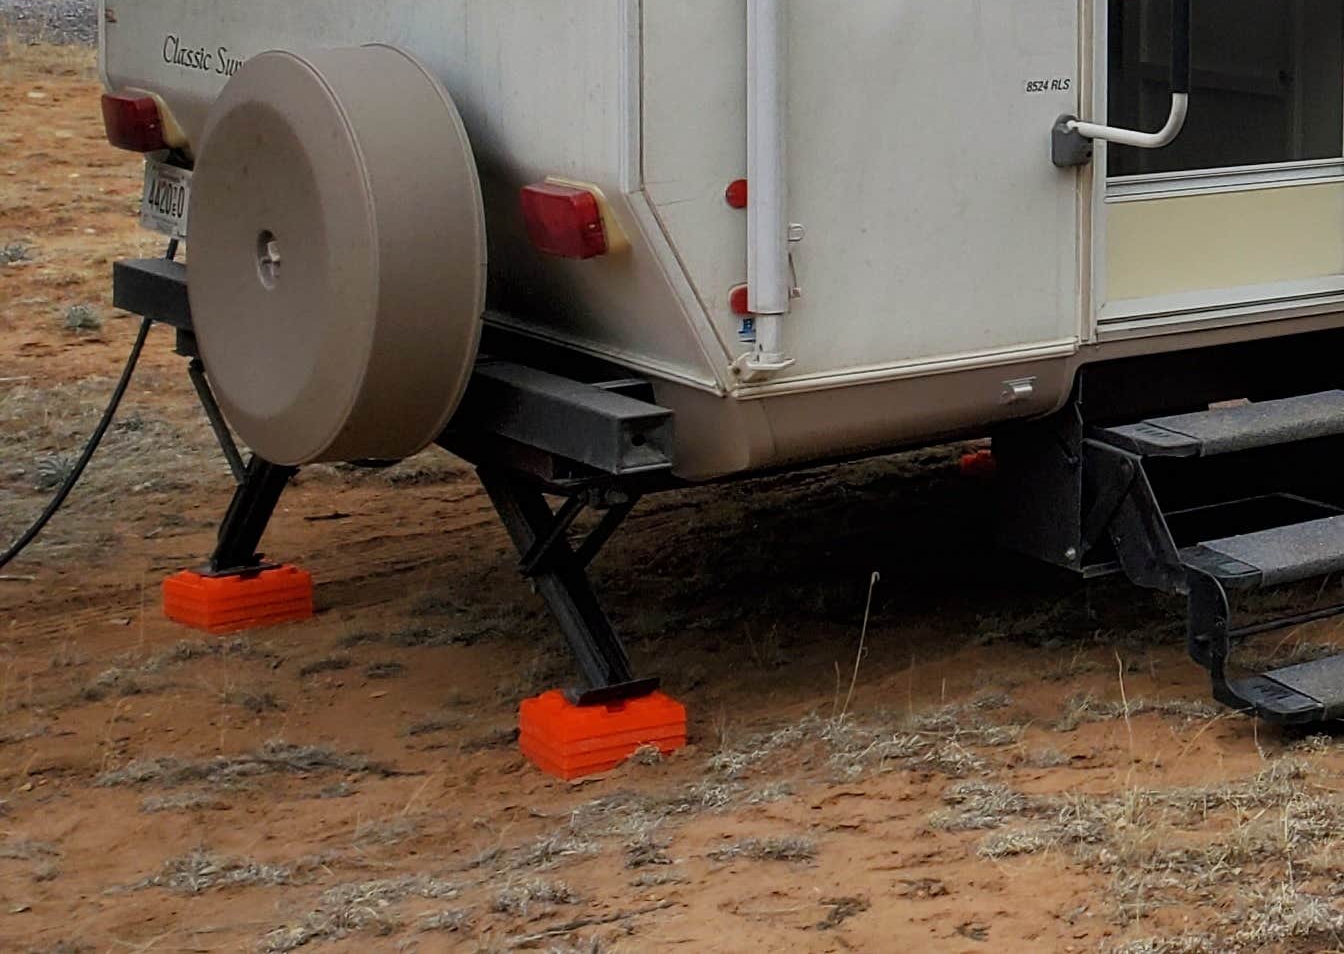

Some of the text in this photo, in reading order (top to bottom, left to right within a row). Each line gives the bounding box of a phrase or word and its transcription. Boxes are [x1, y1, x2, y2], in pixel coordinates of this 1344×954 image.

[162, 34, 213, 71] Classic
[1026, 78, 1072, 92] 8524 RLS
